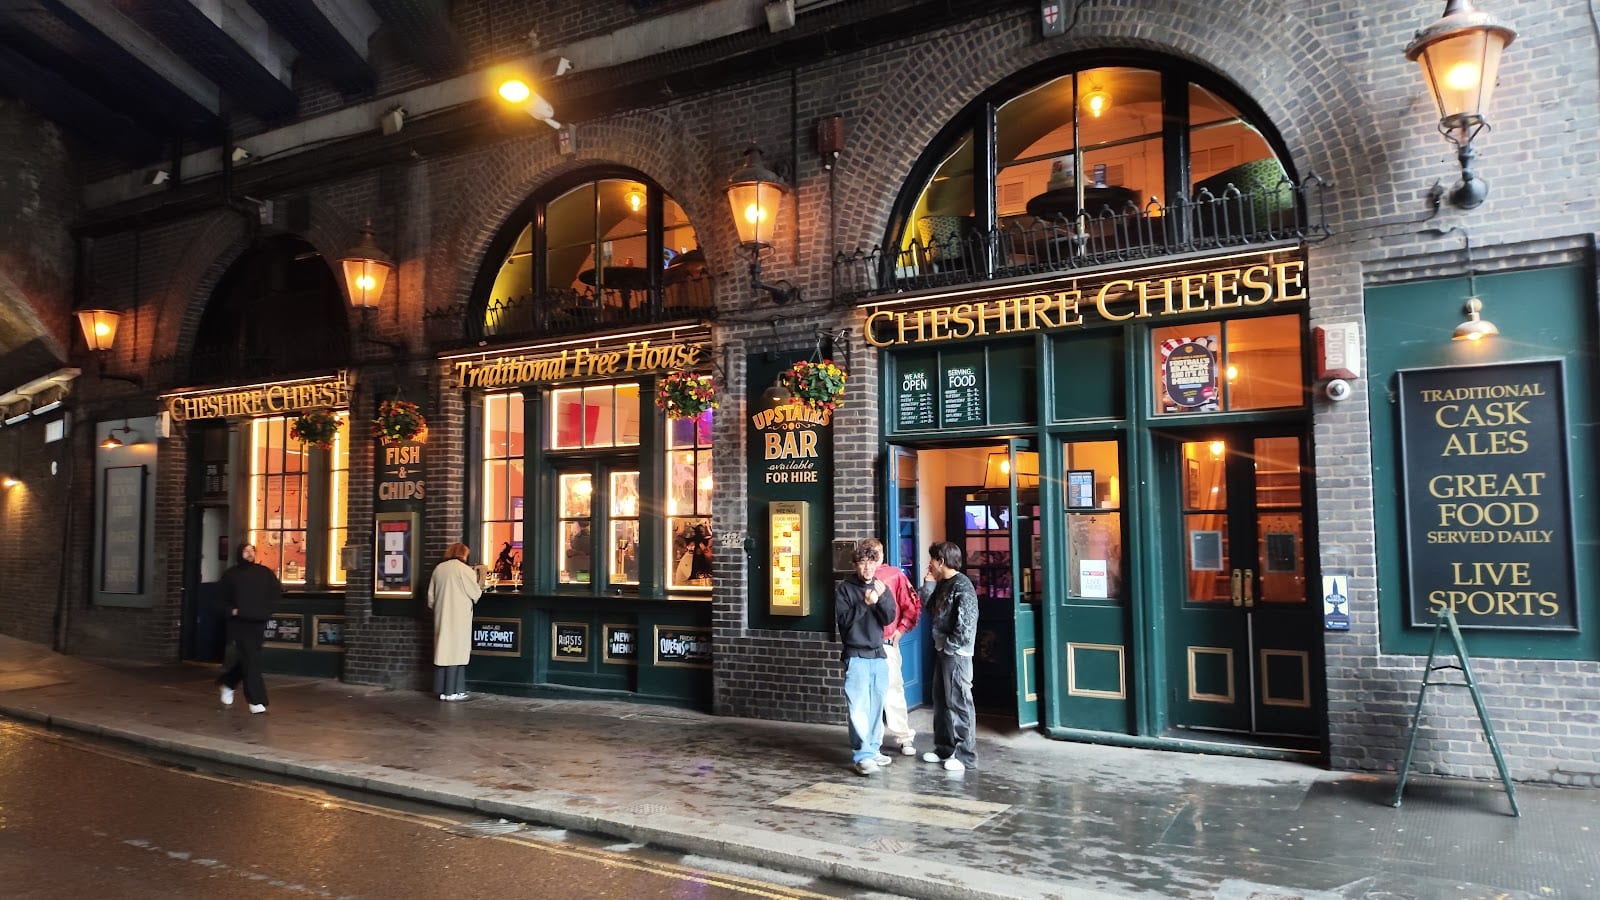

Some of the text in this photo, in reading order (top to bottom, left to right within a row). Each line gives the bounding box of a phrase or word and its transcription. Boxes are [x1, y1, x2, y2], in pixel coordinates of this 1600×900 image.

[863, 261, 1308, 349] CHESHIRE CHEESE
[455, 341, 701, 388] Traditional Free House
[902, 379, 927, 391] OPEN
[913, 372, 925, 380] ARE
[949, 375, 976, 388] FOOD
[169, 381, 349, 422] CHESHIRE CHEESE
[1420, 383, 1545, 402] TRADITIONAL
[752, 404, 832, 430] UPSTAIRS
[1434, 401, 1531, 429] CASK
[764, 430, 818, 460] BAR
[1441, 430, 1529, 457] ALES
[385, 446, 420, 465] FISH
[768, 459, 814, 471] available
[398, 466, 407, 479] &
[766, 471, 818, 483] FOR HIRE
[379, 480, 425, 500] CHIPS
[1429, 472, 1546, 499] GREAT
[1437, 502, 1539, 527] FOOD
[1427, 530, 1554, 544] SERVED DAILY
[1452, 562, 1531, 586] LIVE
[1428, 590, 1560, 617] SPORTS
[474, 630, 514, 643] LIVE SPORT
[613, 632, 631, 642] NEW
[612, 643, 634, 654] MENU
[660, 638, 685, 655] QUEENS
